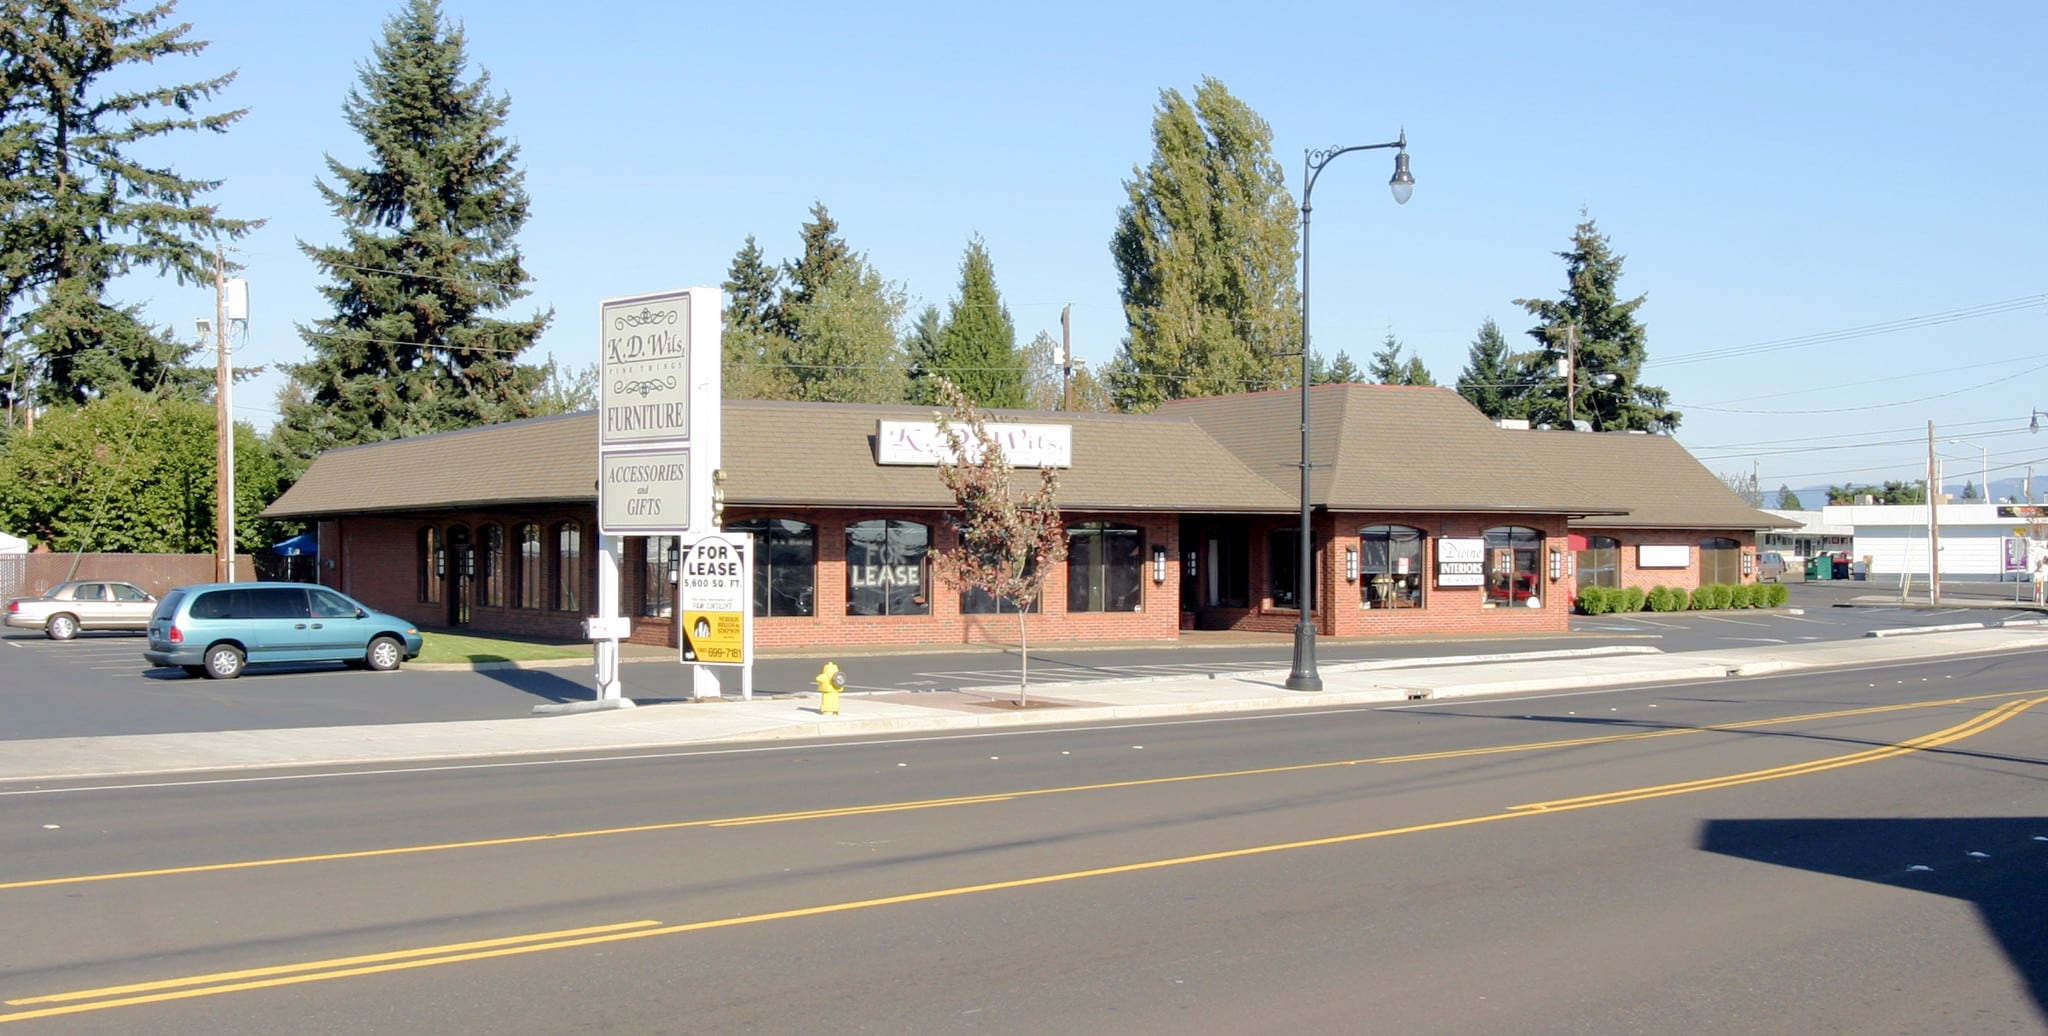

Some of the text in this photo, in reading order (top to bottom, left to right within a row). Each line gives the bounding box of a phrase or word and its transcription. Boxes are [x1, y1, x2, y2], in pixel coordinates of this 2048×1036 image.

[607, 402, 684, 432] FURNITURE
[607, 463, 685, 483] ACCESSORIES
[637, 485, 650, 494] and
[627, 498, 662, 516] GIFTS
[698, 546, 728, 560] FOR
[866, 544, 906, 566] FOR
[689, 562, 737, 576] LEASE
[852, 564, 920, 586] LEASE
[1441, 563, 1483, 574] INTERIORS
[684, 579, 709, 588] 5,600
[712, 579, 727, 588] SQ.
[708, 647, 742, 658] 699-7181
